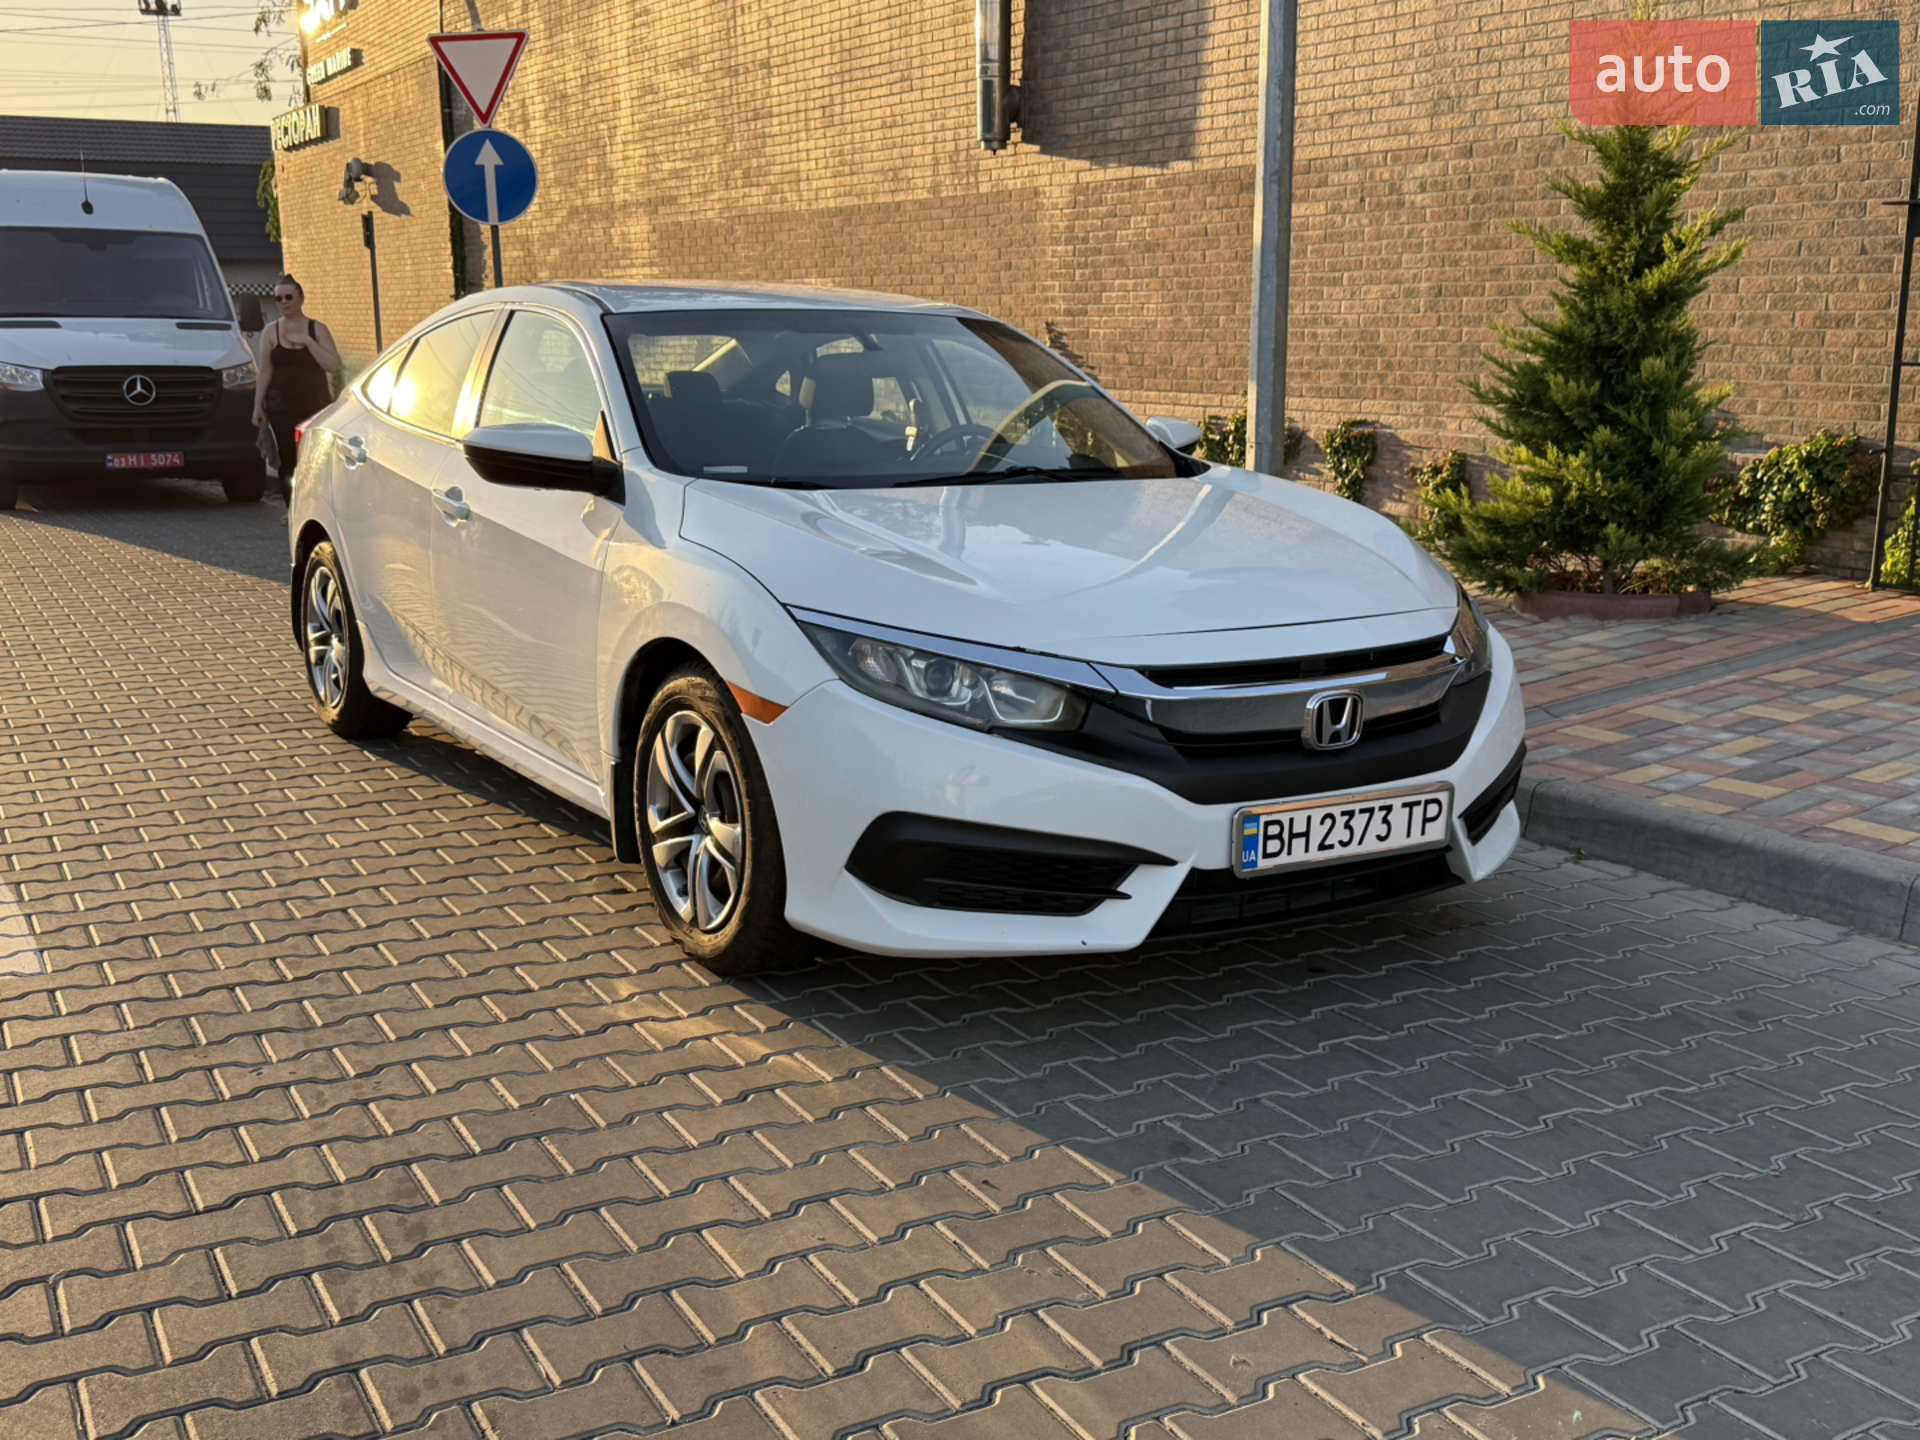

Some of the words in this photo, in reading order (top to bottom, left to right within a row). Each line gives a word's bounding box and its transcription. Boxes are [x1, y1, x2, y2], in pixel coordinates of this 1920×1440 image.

[151, 454, 180, 466] 5074
[1262, 814, 1312, 860] BH
[1317, 804, 1394, 851] 2373
[1401, 797, 1443, 839] TP
[1242, 849, 1257, 863] UA
